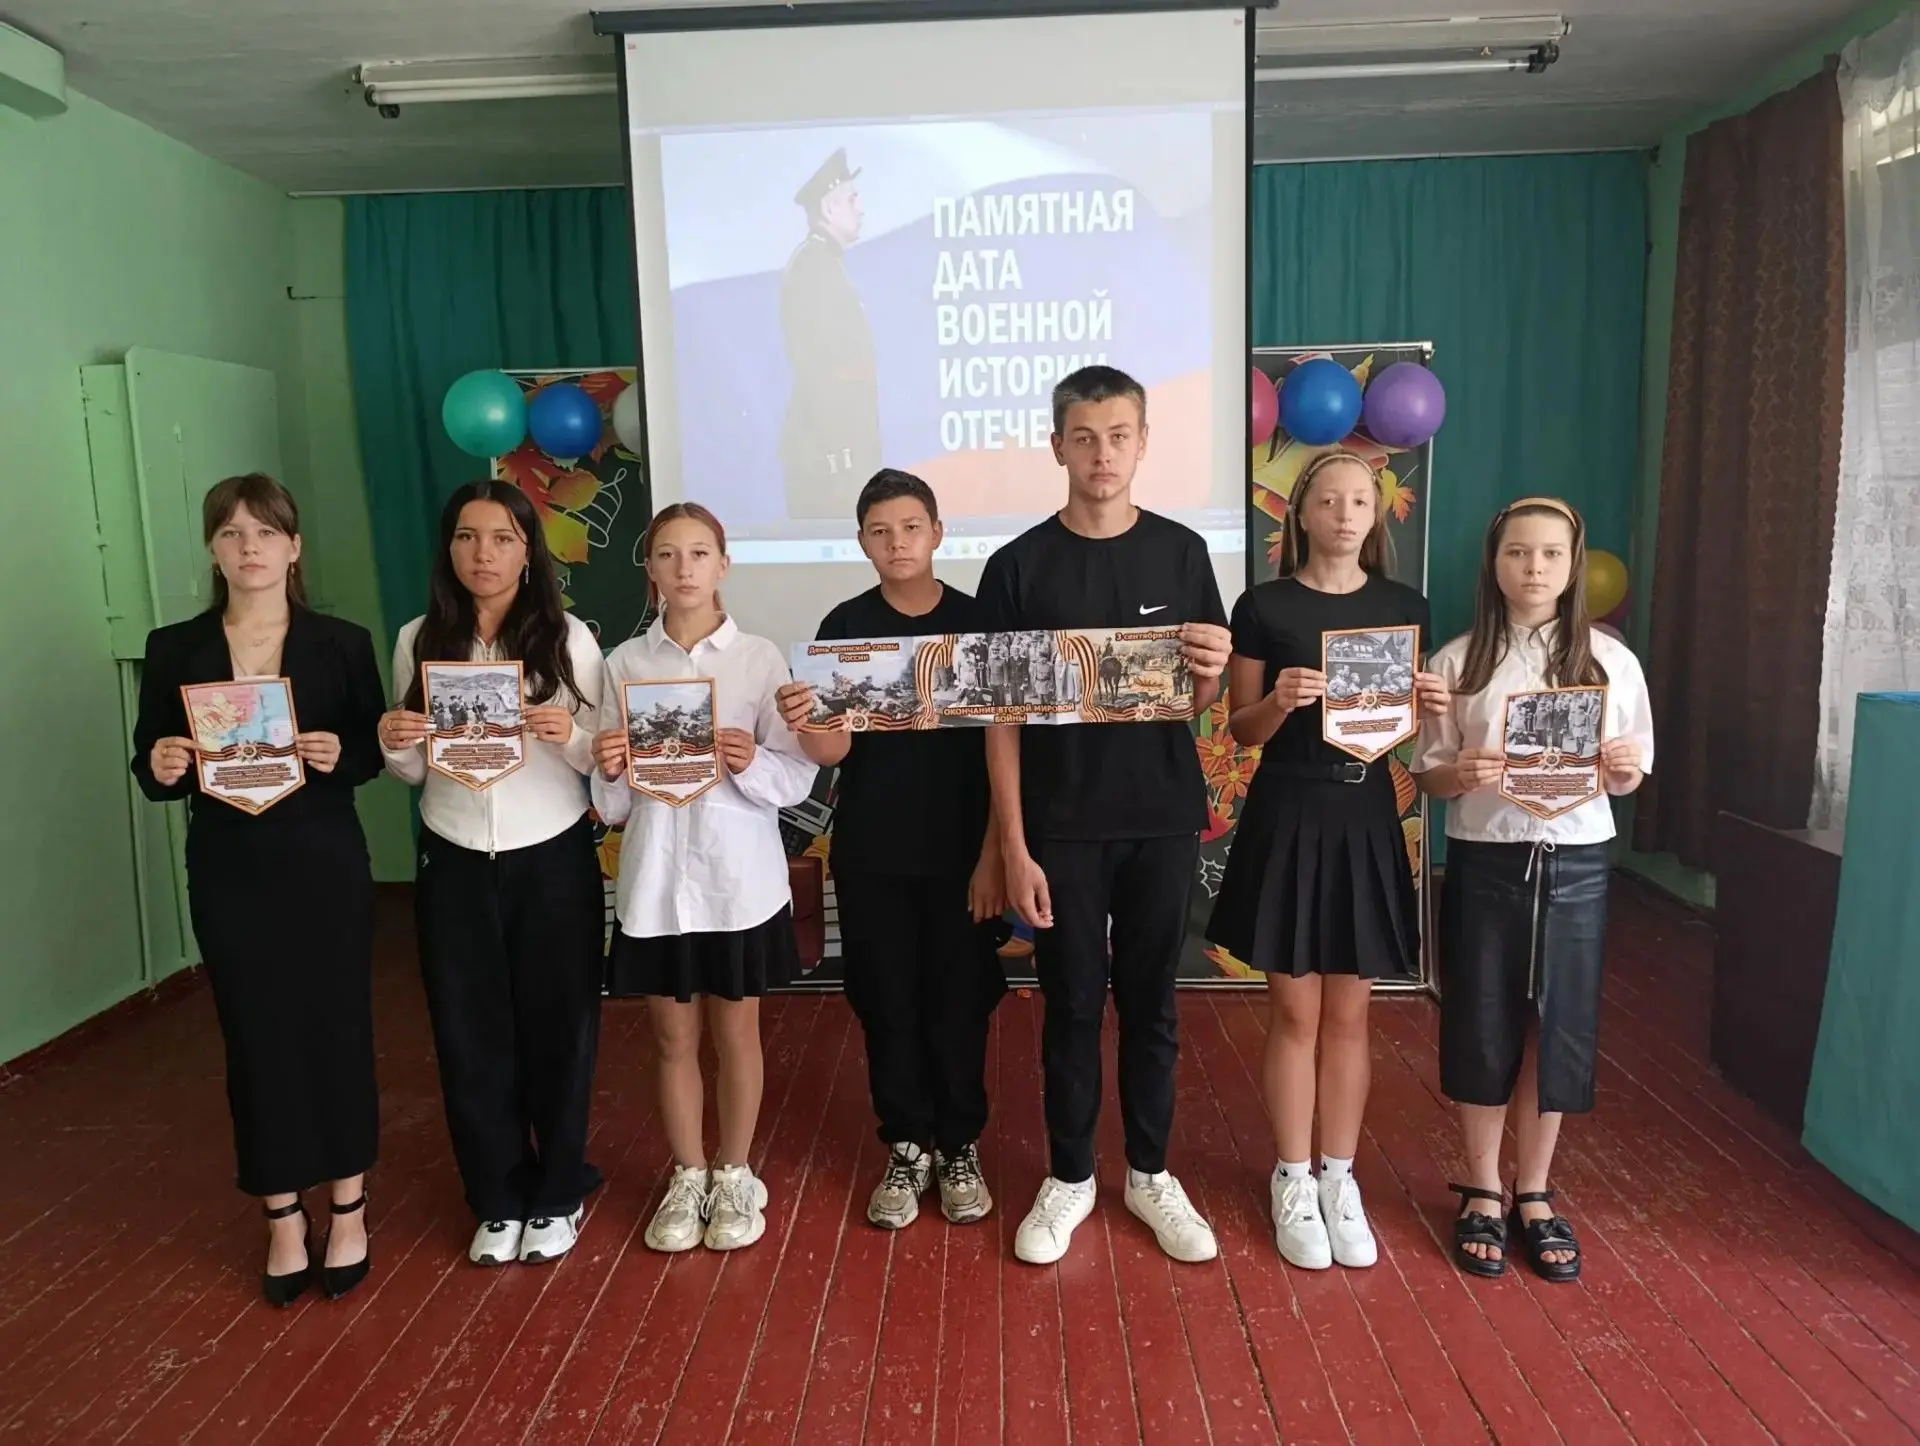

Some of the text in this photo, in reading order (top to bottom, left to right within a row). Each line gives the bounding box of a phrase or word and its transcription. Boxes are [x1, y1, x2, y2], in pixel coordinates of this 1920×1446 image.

[933, 189, 1135, 238] ПАМЯТНАЯ
[932, 249, 1023, 300] ДАТА
[937, 289, 1113, 346] ВОЕННОЙ
[940, 408, 1050, 451] ОТЕЧЕ
[1115, 631, 1122, 641] 3
[808, 645, 830, 656] День
[839, 654, 869, 662] России
[943, 703, 1075, 716] ОКОНЧАНИЕ ВТОРОЙ МИРОВОЙ
[994, 714, 1027, 724] ВОЙНЫ
